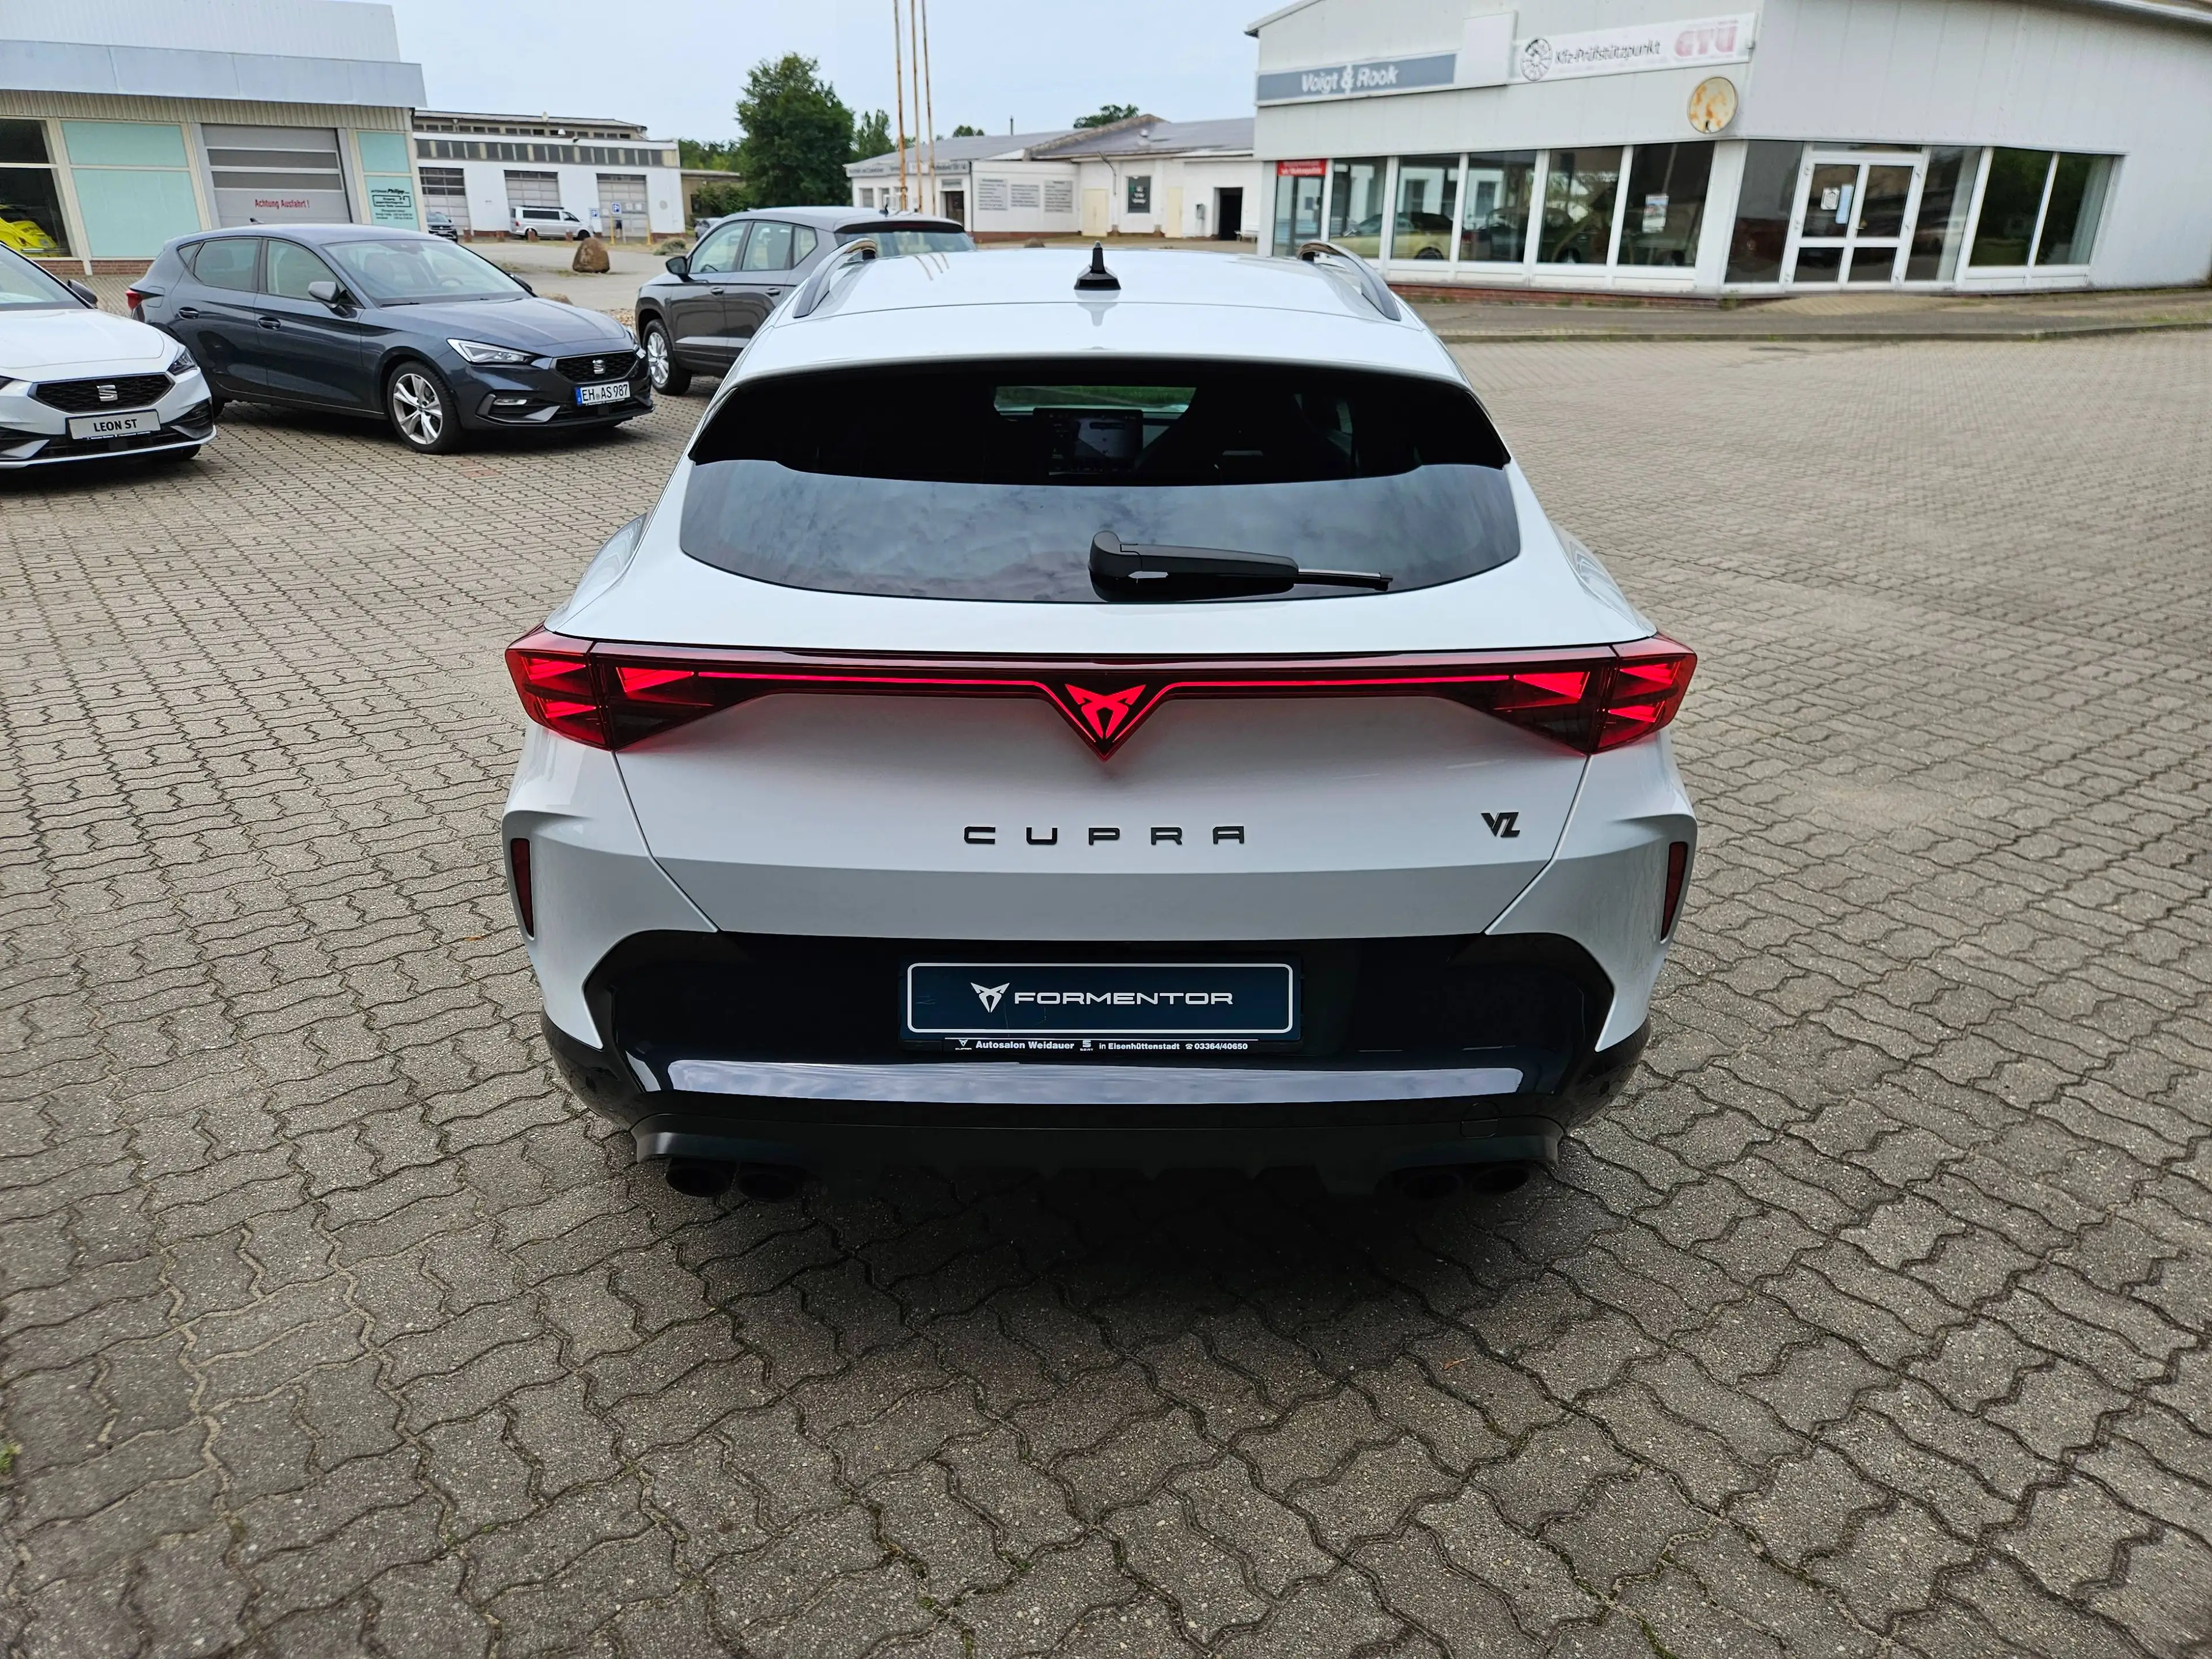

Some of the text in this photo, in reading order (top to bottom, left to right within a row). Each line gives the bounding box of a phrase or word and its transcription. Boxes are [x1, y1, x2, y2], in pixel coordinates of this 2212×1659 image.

[1301, 71, 1338, 94] Voigt
[1340, 65, 1355, 95] &
[255, 199, 279, 209] Achtung
[281, 200, 306, 208] Ausfahrt
[582, 384, 628, 402] EH AS 987
[93, 419, 138, 432] LEON ST
[1480, 812, 1521, 838] VZ
[964, 825, 1244, 845] CUPRA
[1014, 992, 1233, 1005] FORMENTOR
[976, 1041, 1074, 1049] Autosalon Weidauer
